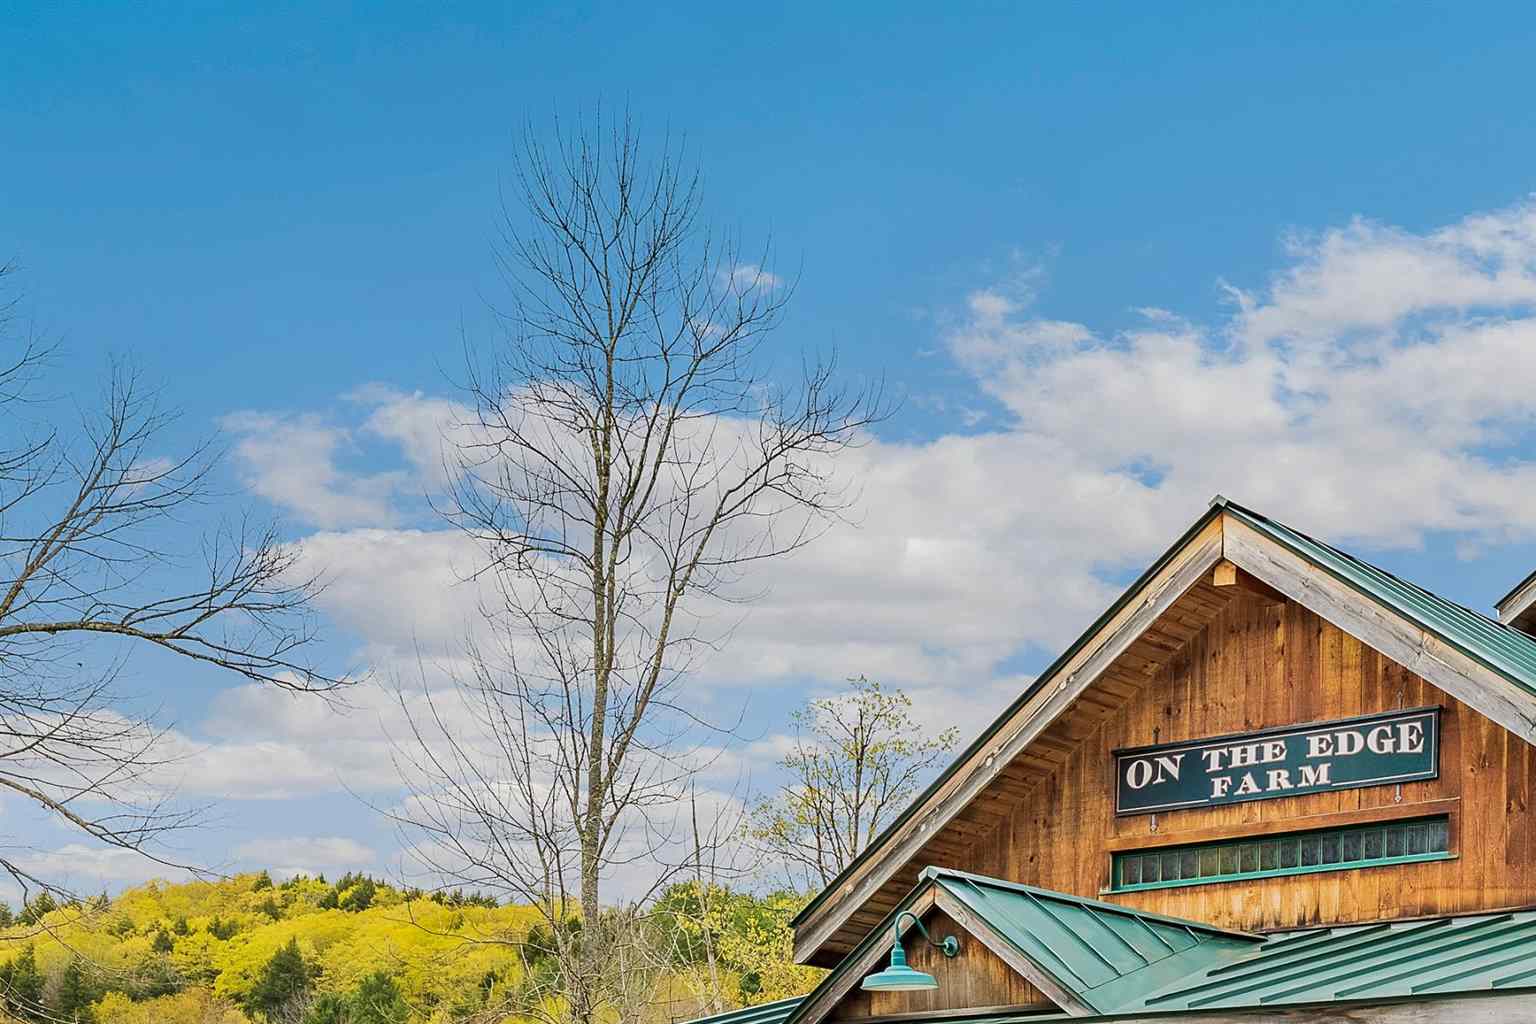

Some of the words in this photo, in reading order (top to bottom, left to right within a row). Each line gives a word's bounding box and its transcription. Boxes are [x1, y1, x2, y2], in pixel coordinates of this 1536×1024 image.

[1126, 754, 1185, 790] ON
[1202, 740, 1288, 773] THE
[1306, 721, 1425, 759] EDGE
[1210, 763, 1331, 798] FARM
